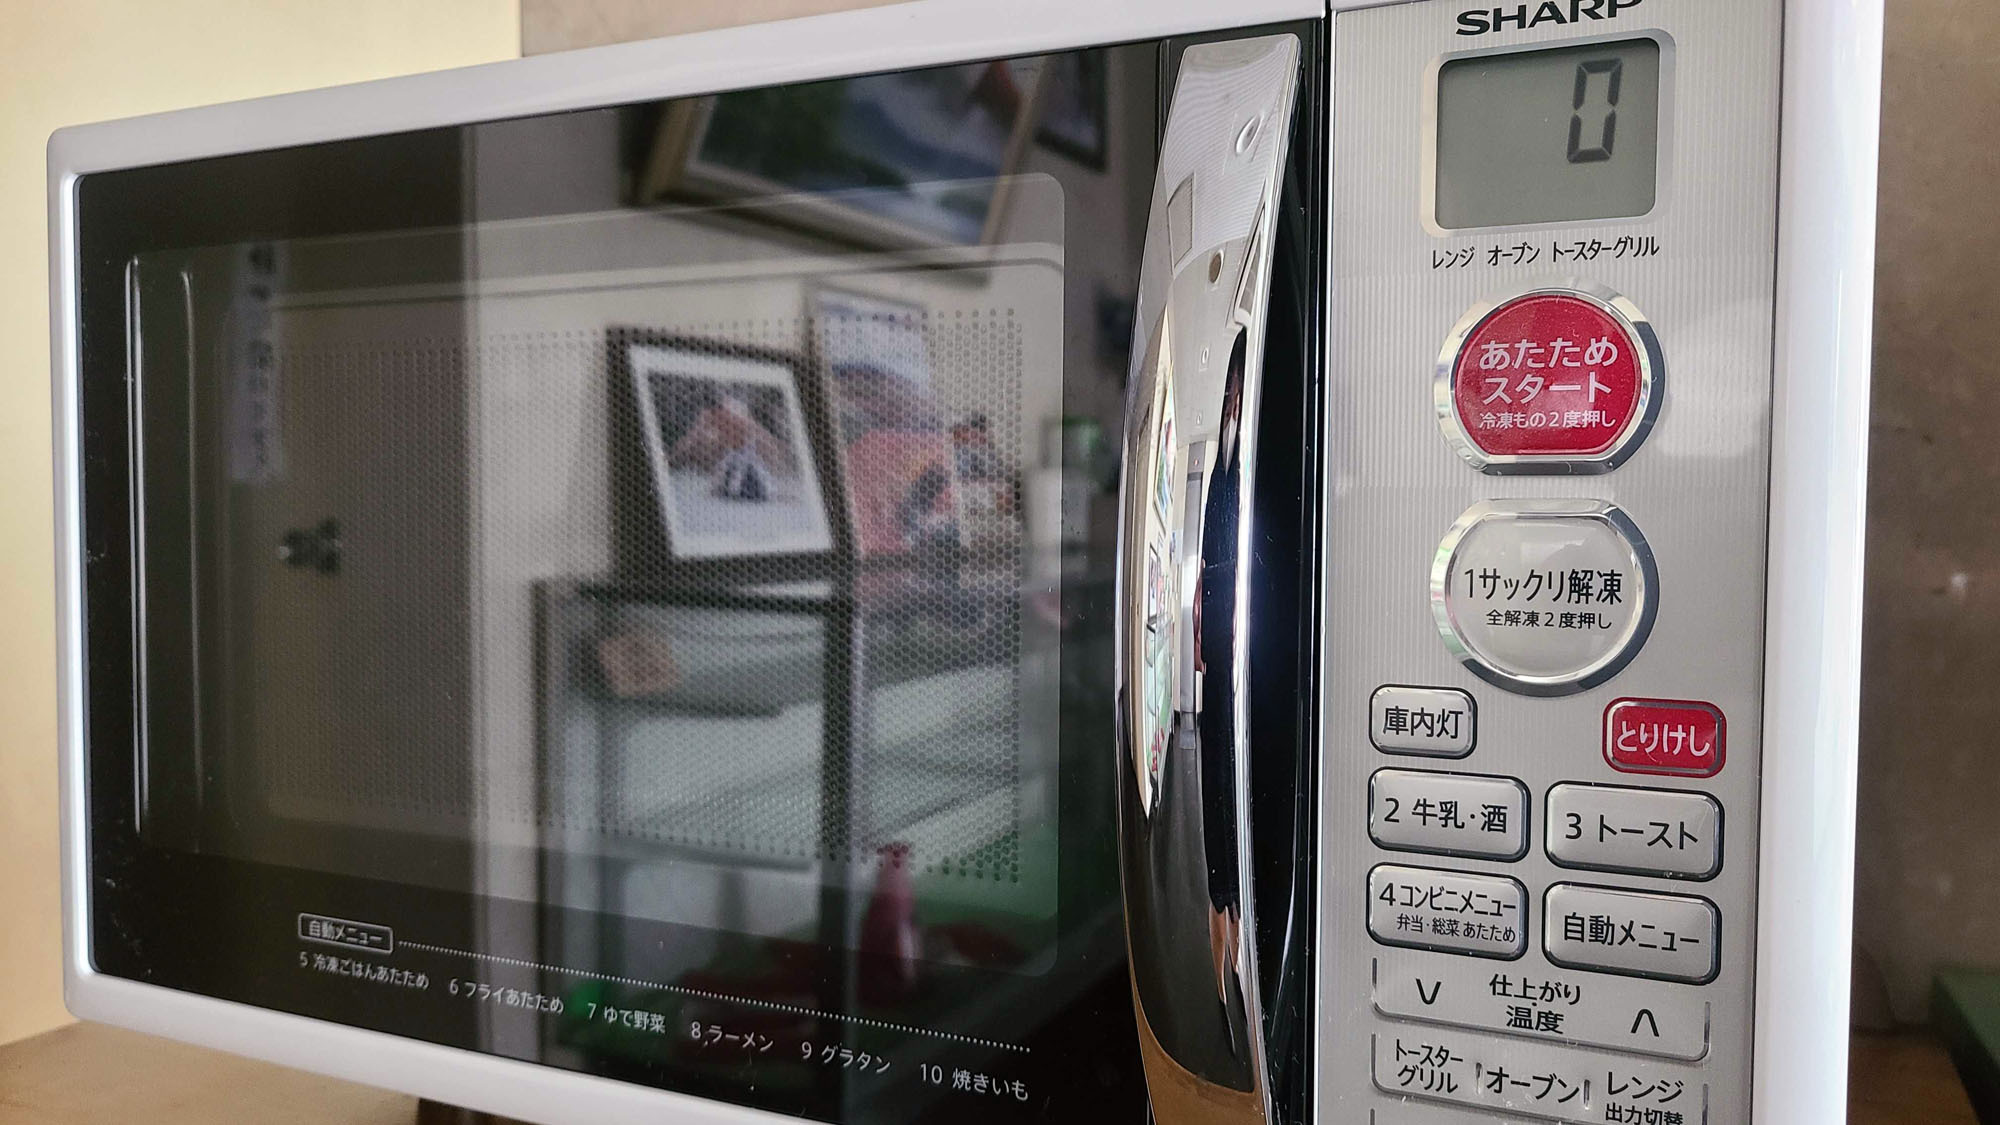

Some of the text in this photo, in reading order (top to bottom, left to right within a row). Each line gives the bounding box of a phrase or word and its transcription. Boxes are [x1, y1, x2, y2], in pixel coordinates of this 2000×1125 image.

[1455, 0, 1643, 36] SHARP
[1566, 57, 1624, 165] 0
[1432, 235, 1660, 270] レンジ オーブン トースターグリル
[1478, 336, 1619, 370] あたため
[1482, 370, 1613, 405] スタート
[1479, 409, 1616, 429] 冷凍もの2度押し
[1485, 608, 1612, 630] 全解凍2度押し
[1382, 706, 1464, 740] 庫内灯
[1615, 720, 1712, 757] とりけし
[1599, 814, 1699, 851] トースト
[308, 919, 384, 947] 自動メニュー
[1462, 921, 1517, 944] あたため
[1563, 911, 1701, 953] 自動メニュー
[312, 952, 430, 990] 冷凍ごはんあたため
[465, 982, 565, 1015] フライあたため
[1489, 973, 1582, 1006] 仕上がり
[603, 1006, 666, 1034] ゆで野菜
[1506, 1005, 1565, 1036] 温度
[708, 1024, 774, 1052] ラーメン
[1395, 1038, 1465, 1067] トースター
[821, 1045, 891, 1075] グラタン
[920, 1062, 1030, 1102] 10 焼きいも
[1397, 1063, 1459, 1095] グリル
[1485, 1065, 1581, 1104] オーブン
[1607, 1070, 1685, 1104] レンジ
